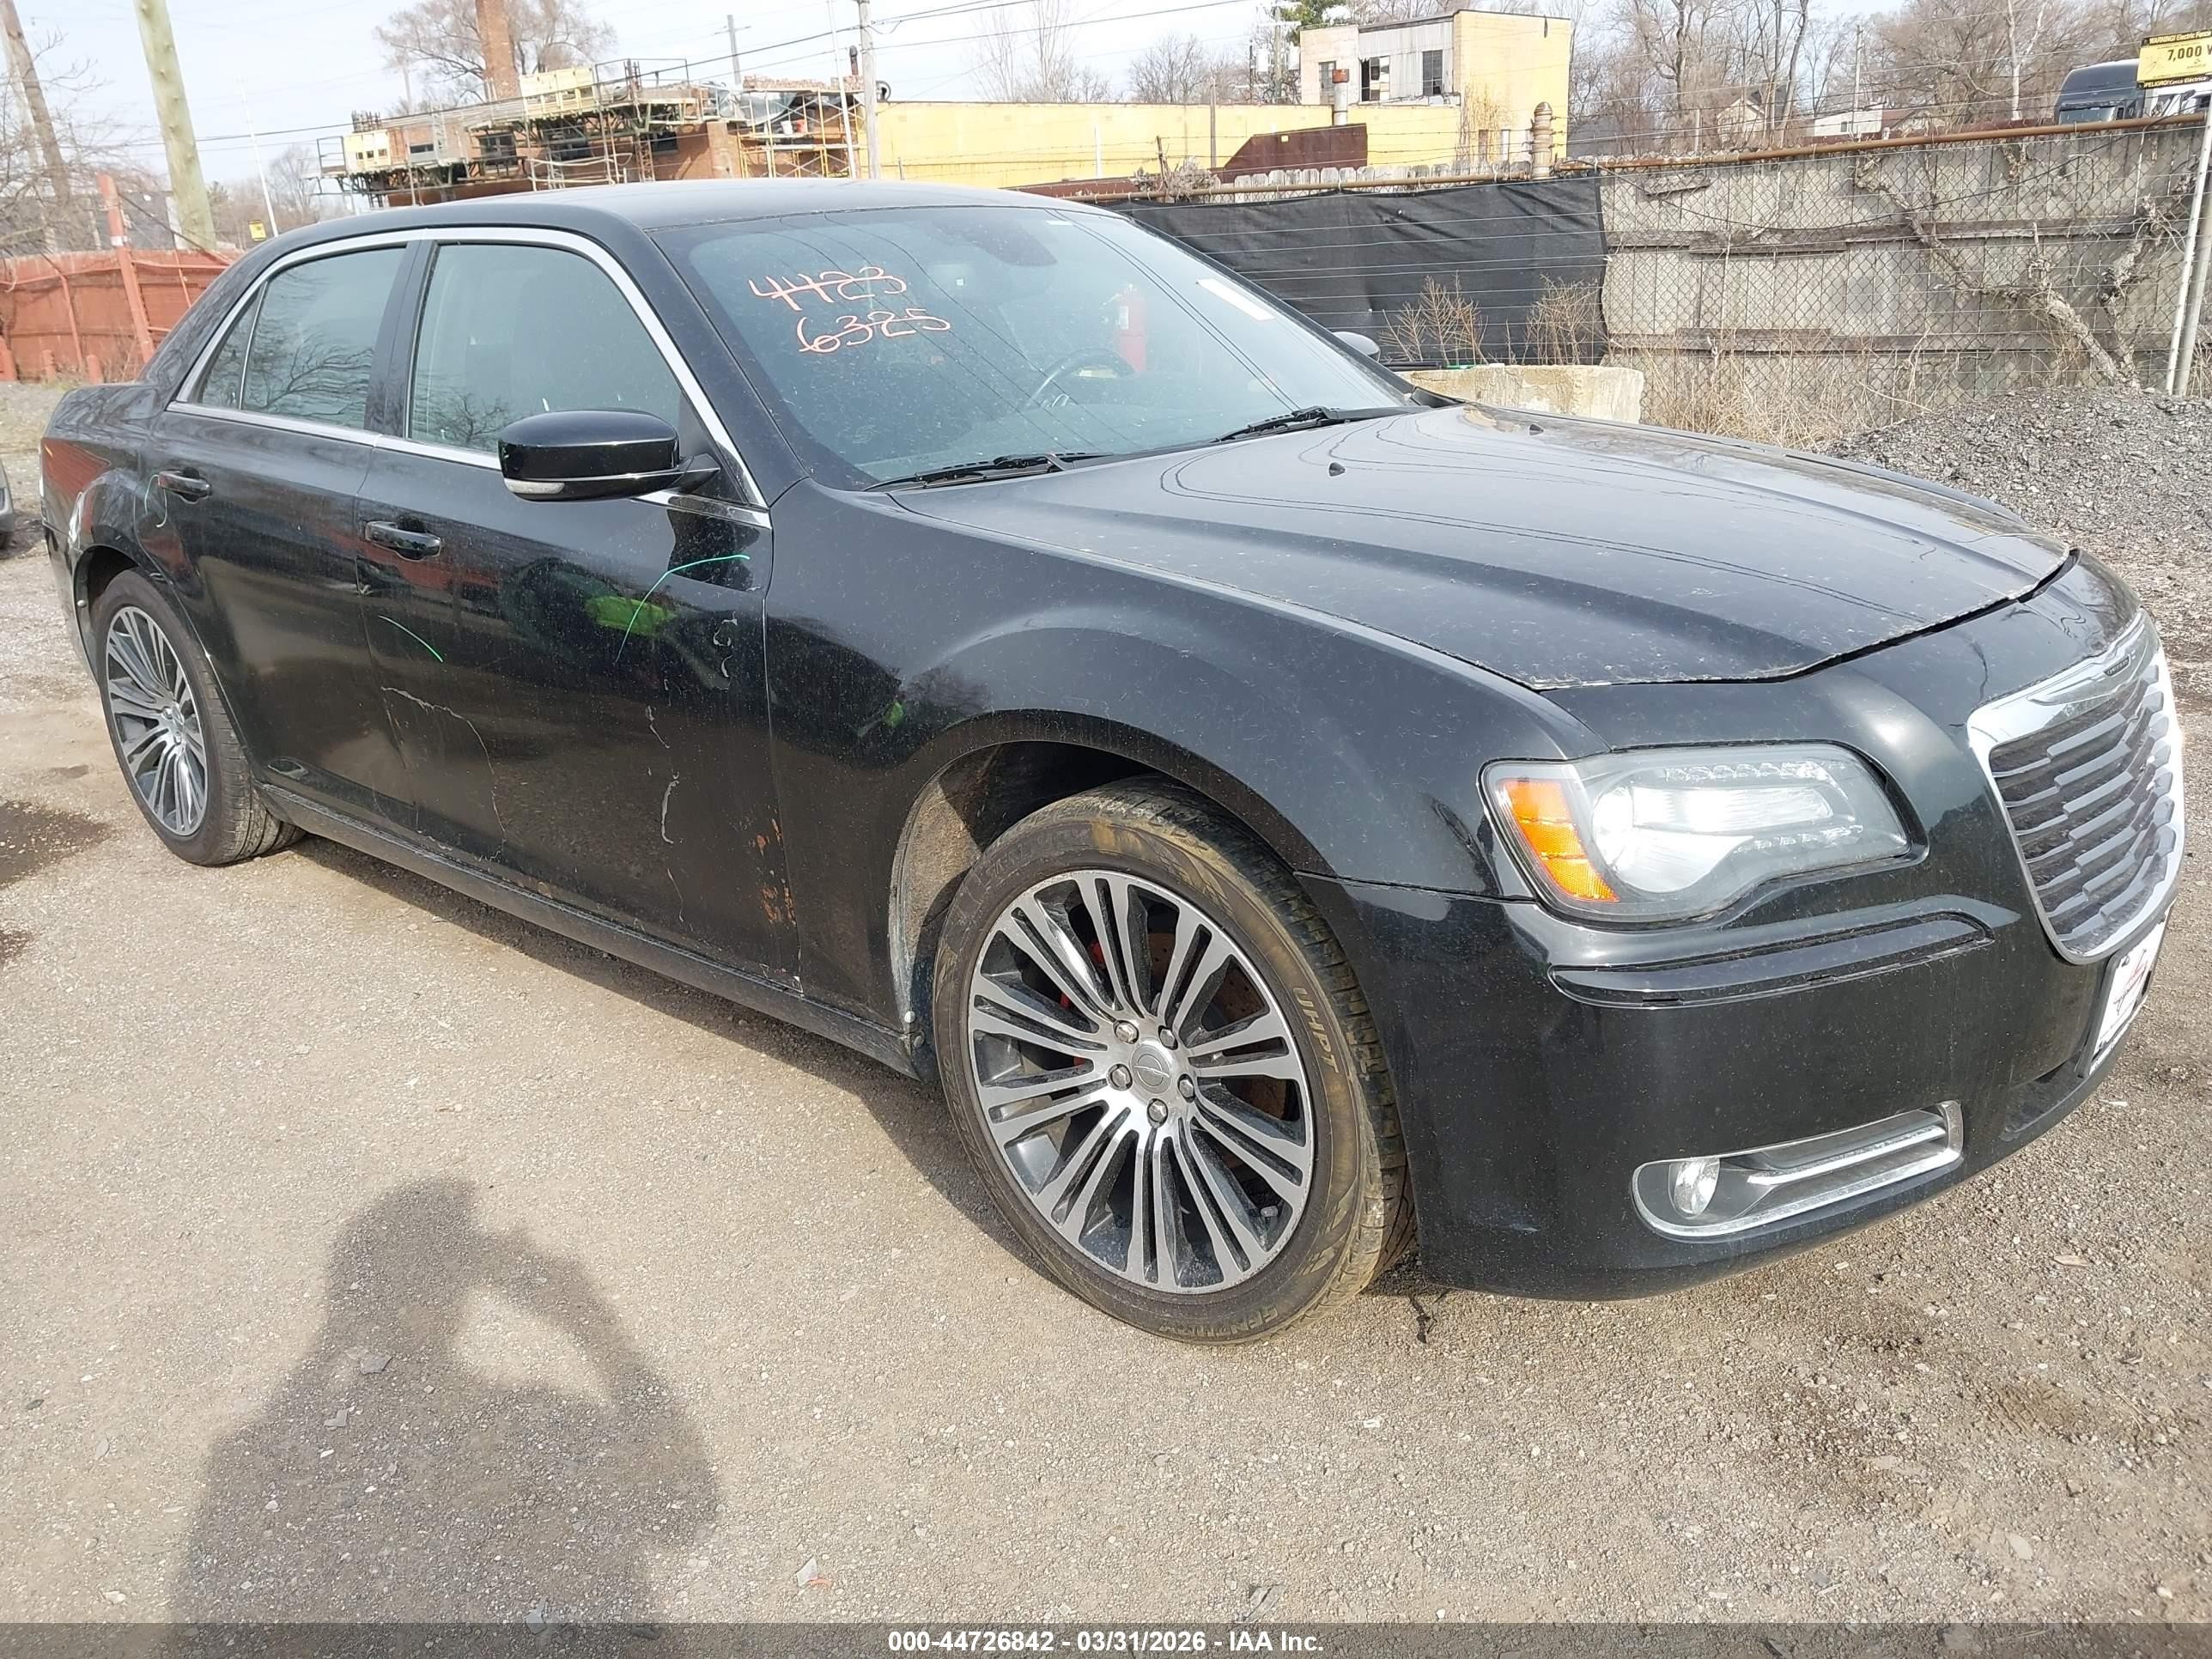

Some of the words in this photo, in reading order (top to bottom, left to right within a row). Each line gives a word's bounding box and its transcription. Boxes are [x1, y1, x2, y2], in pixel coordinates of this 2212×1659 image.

[2167, 46, 2203, 62] 7,000
[748, 266, 907, 312] 4423
[796, 308, 951, 353] 6325
